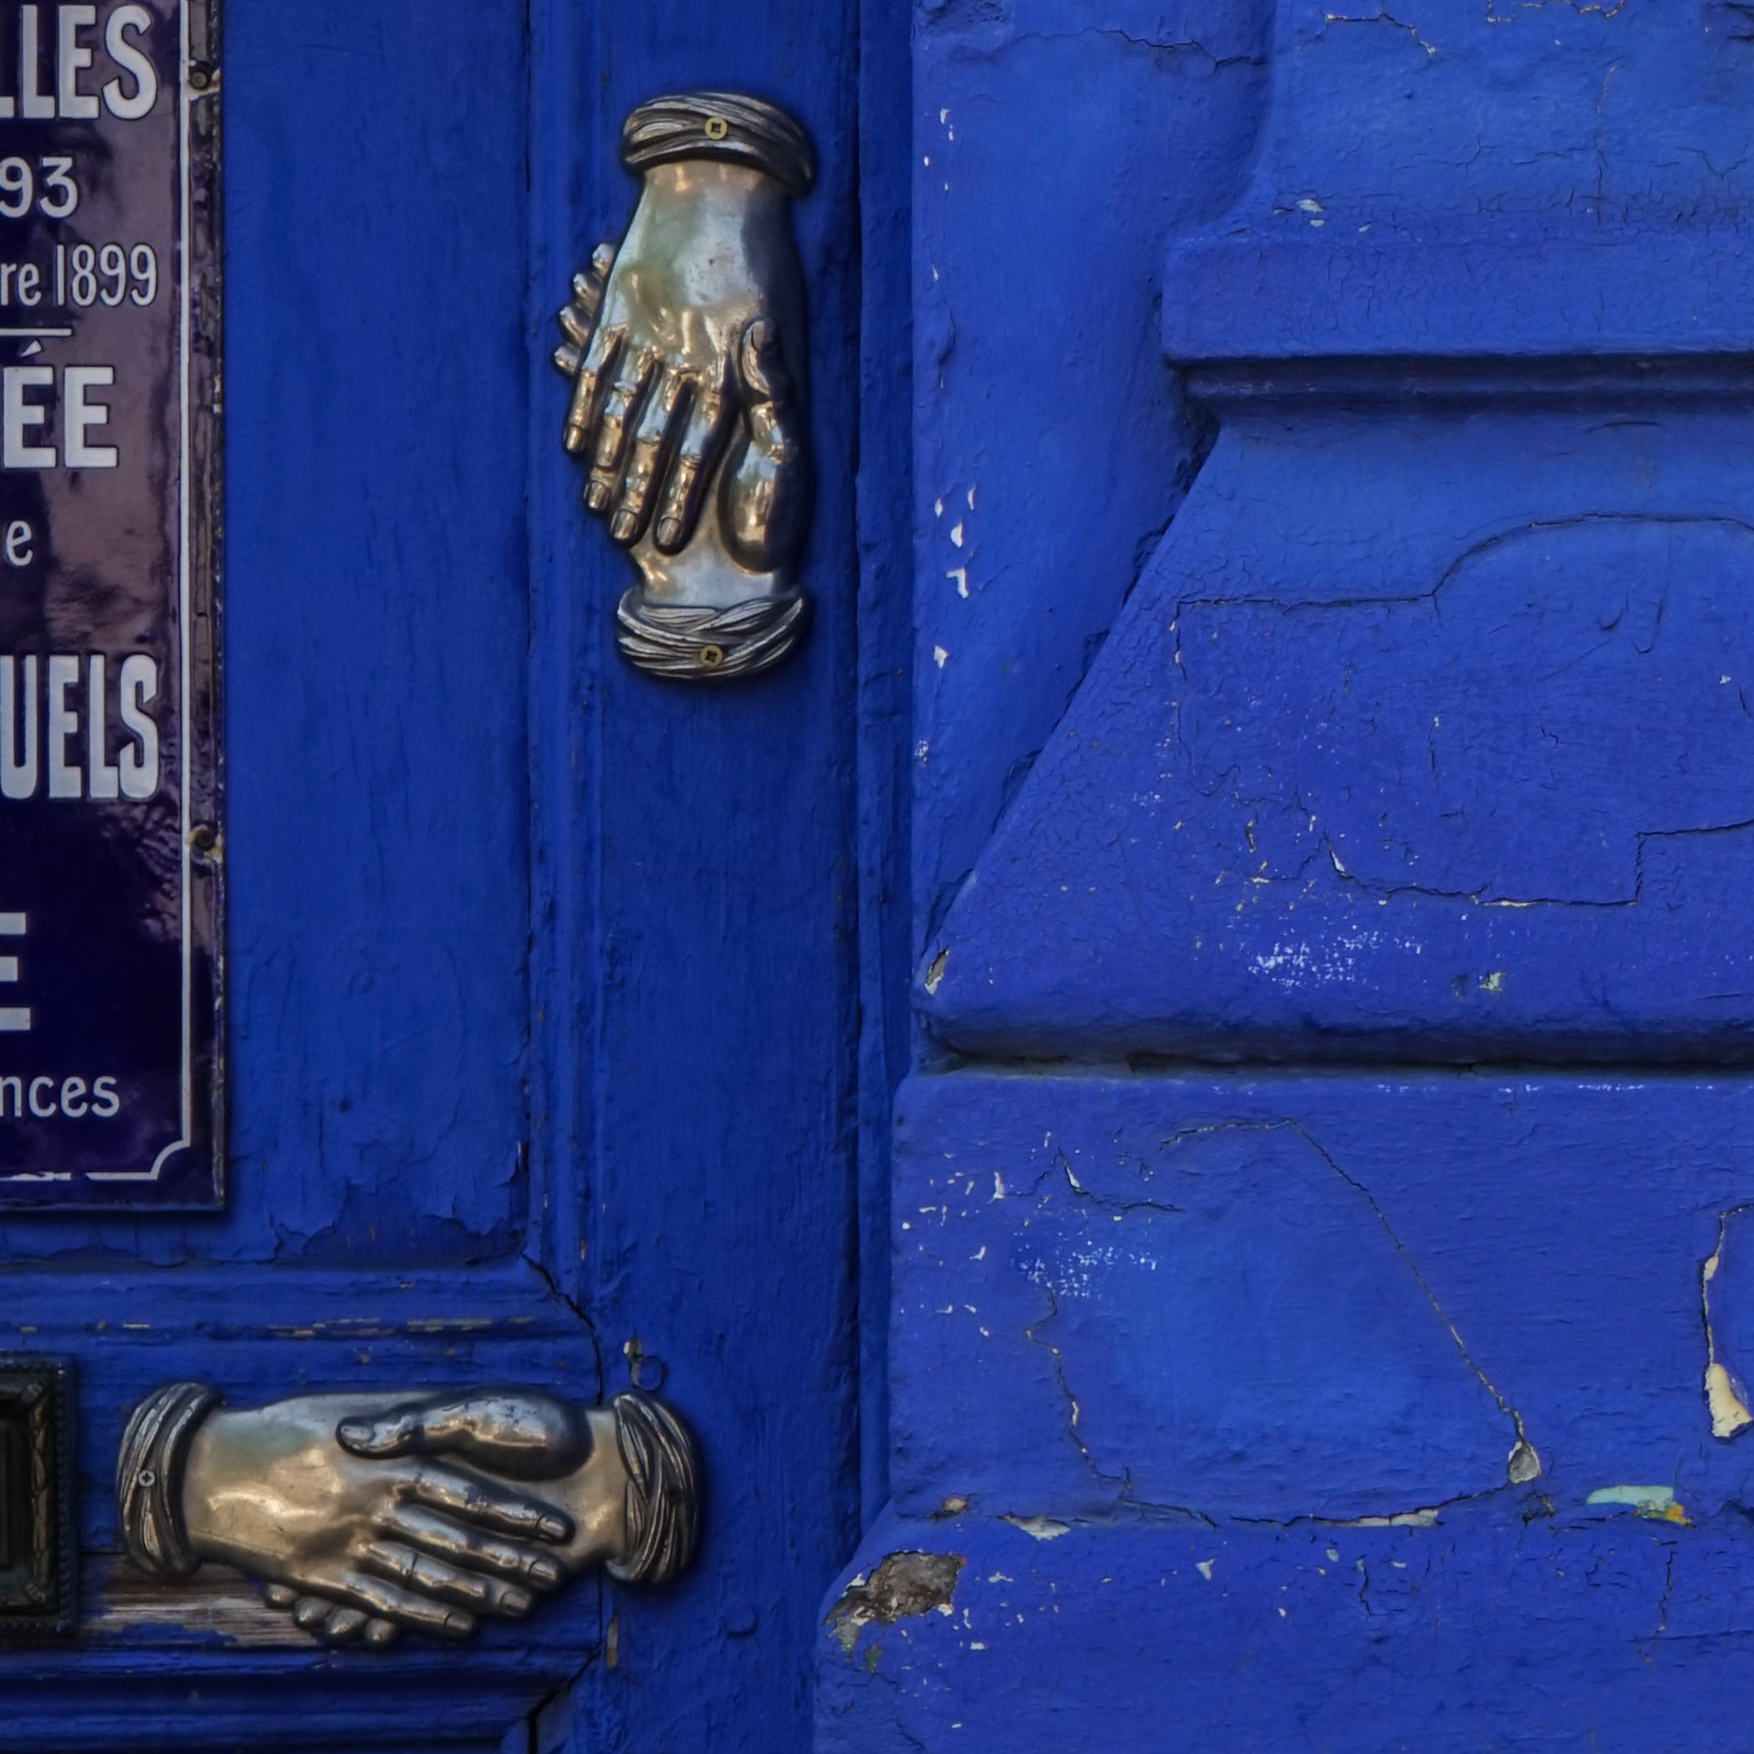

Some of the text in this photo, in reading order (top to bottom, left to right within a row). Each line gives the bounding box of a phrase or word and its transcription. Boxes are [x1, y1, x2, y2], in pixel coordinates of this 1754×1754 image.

[0, 4, 157, 120] LES
[0, 157, 78, 218] 93
[0, 244, 157, 306] re 1899
[4, 340, 117, 467] ÉE
[6, 520, 33, 566] e
[0, 654, 159, 800] UELS
[0, 1075, 120, 1118] nces
